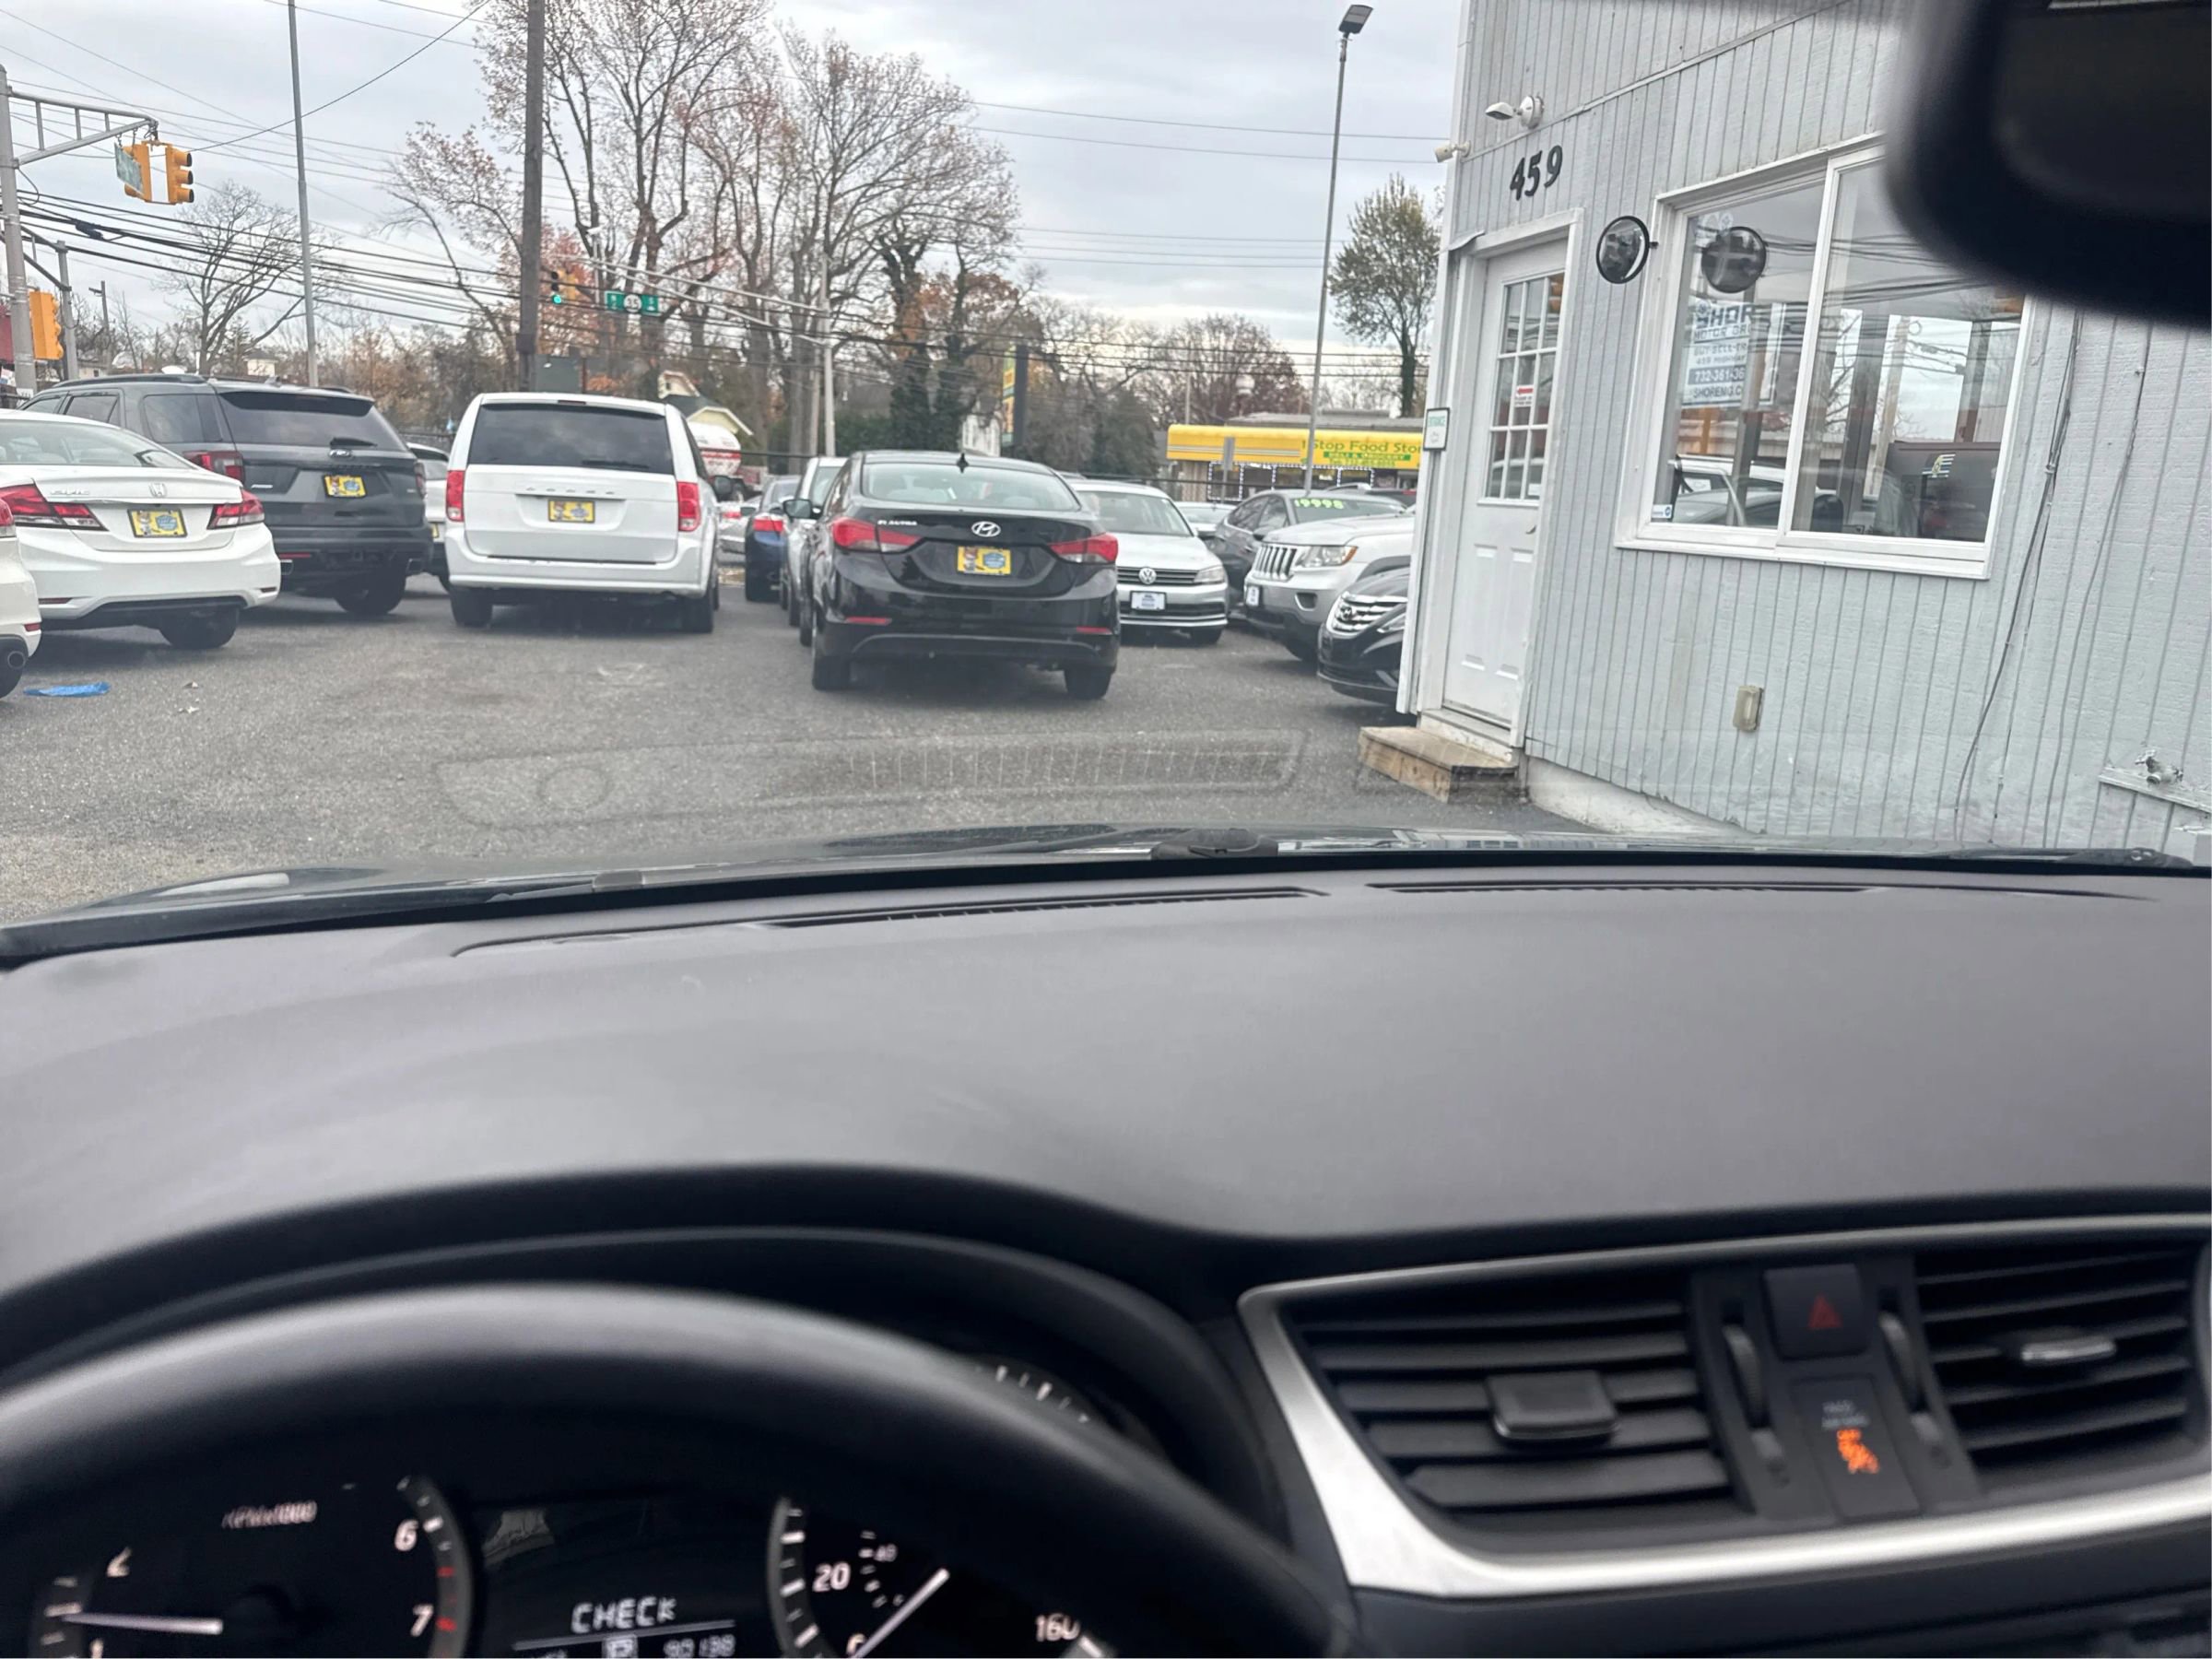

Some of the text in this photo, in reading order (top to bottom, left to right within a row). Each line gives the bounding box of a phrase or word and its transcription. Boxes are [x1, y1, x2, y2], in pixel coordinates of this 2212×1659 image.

[1509, 145, 1563, 201] 459
[1349, 441, 1389, 452] Food
[394, 1519, 418, 1551] 6
[812, 1561, 852, 1593] 20
[410, 1603, 433, 1637] 7
[571, 1595, 677, 1634] CHECK
